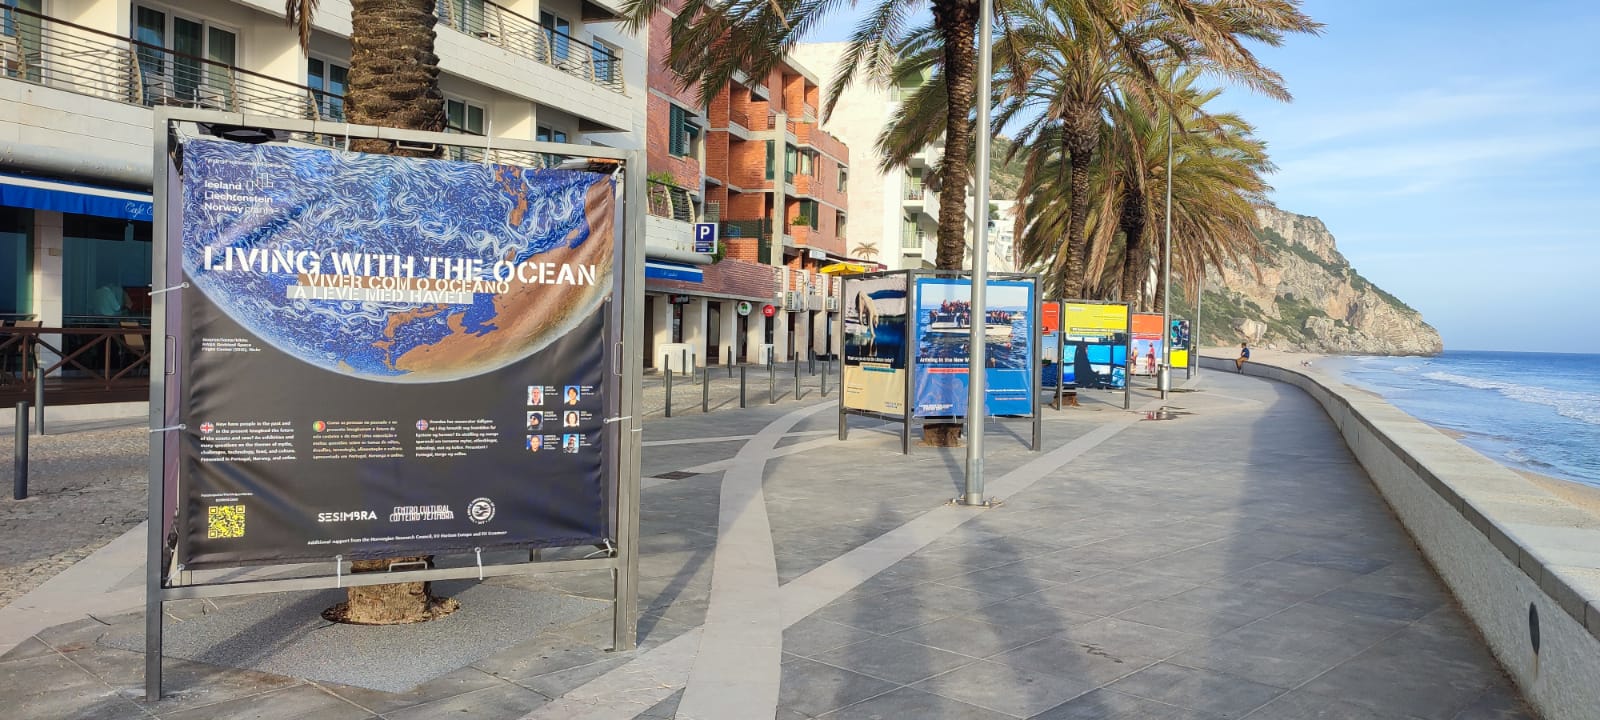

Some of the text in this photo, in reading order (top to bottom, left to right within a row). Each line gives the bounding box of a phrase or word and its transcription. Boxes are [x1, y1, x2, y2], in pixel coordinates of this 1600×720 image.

[204, 191, 273, 204] Liechtenstein
[204, 202, 244, 214] Norway
[701, 226, 710, 240] P
[204, 246, 596, 286] LIVING WITH THE OCEAN
[306, 274, 509, 294] VIVER COM O OCEANO
[312, 286, 360, 300] LEVE
[366, 288, 404, 302] MED
[410, 290, 464, 304] HAVET
